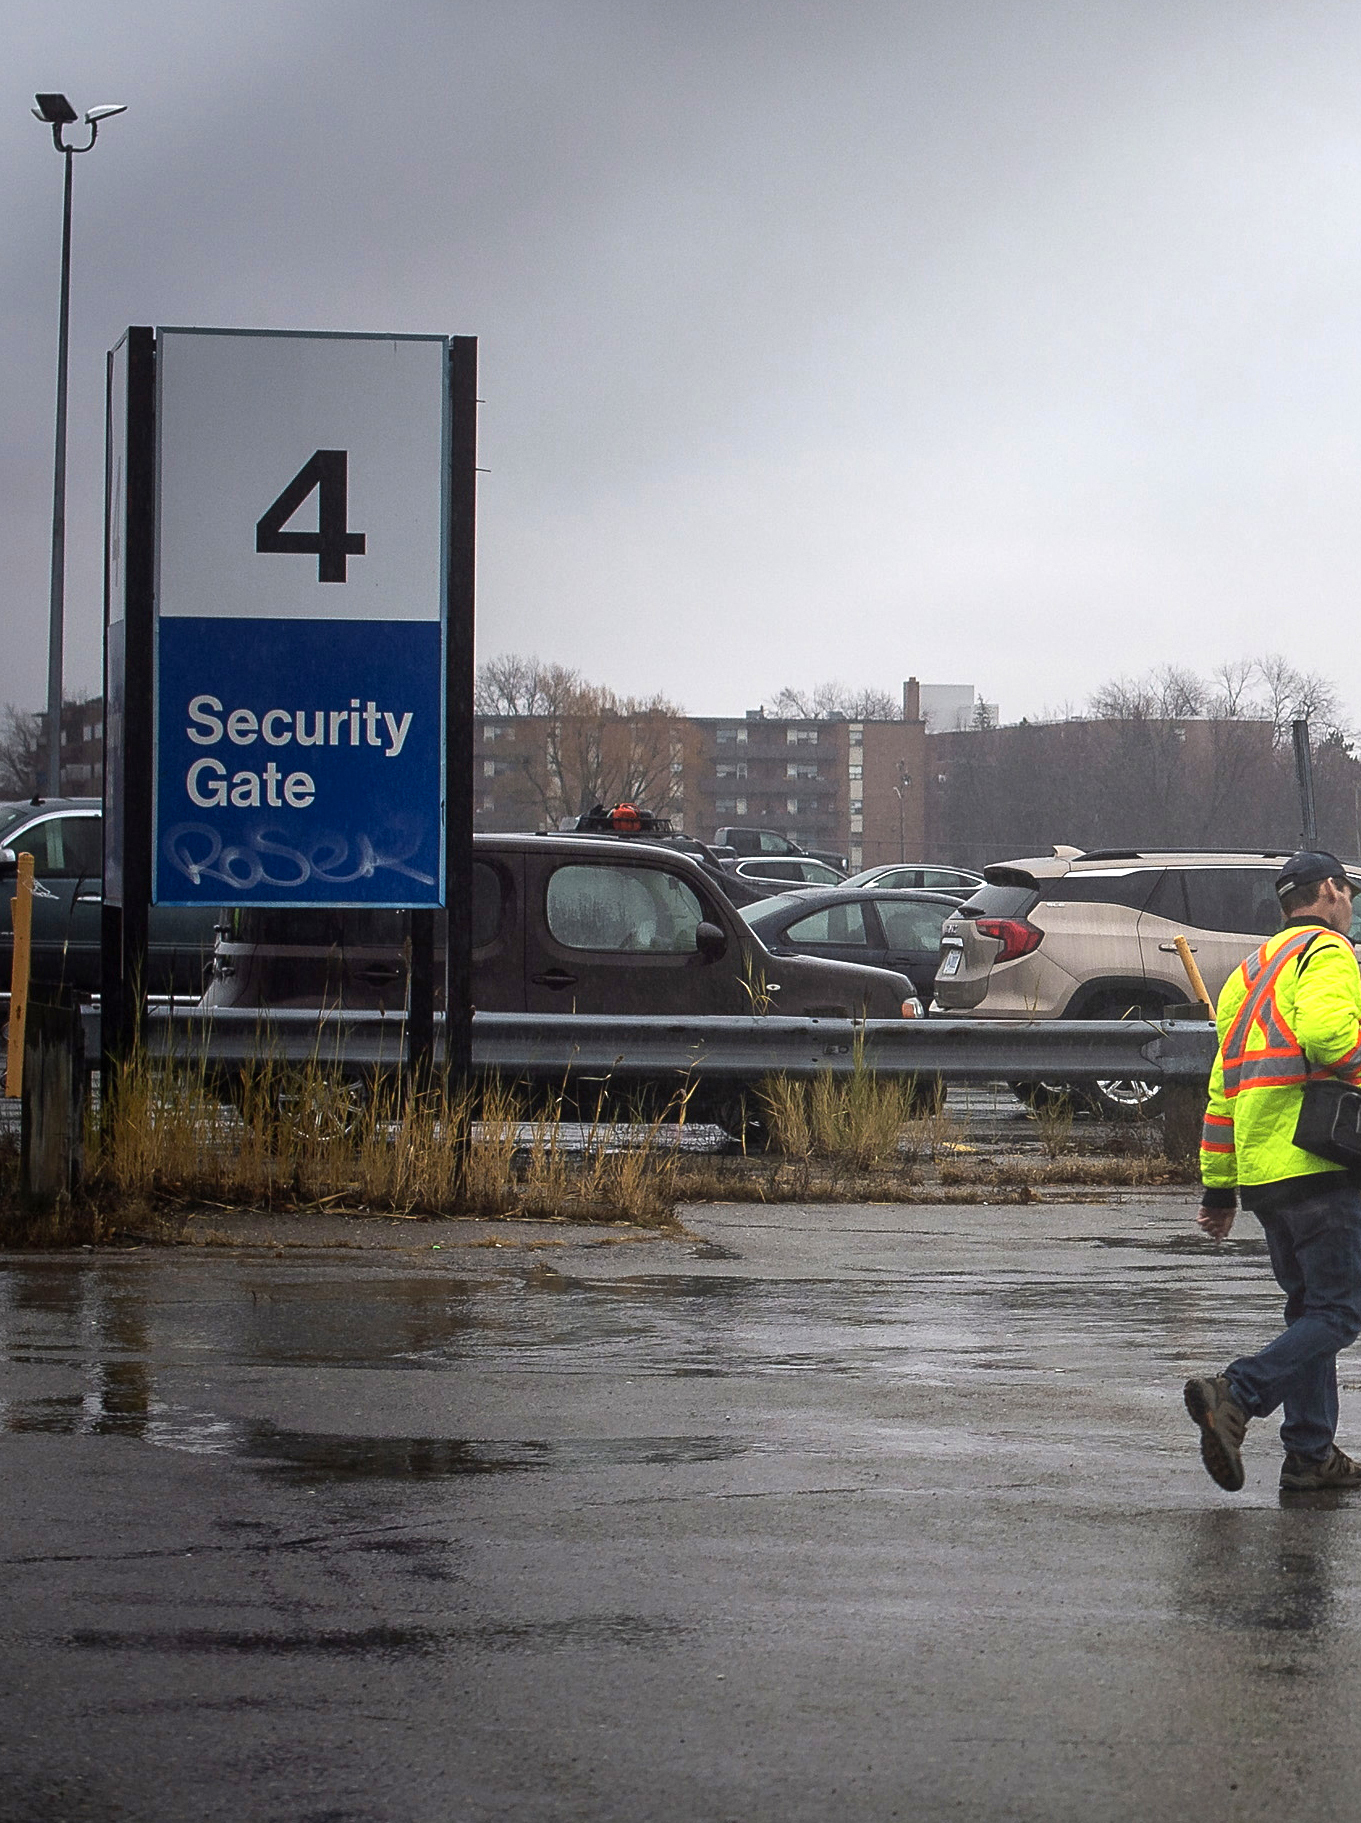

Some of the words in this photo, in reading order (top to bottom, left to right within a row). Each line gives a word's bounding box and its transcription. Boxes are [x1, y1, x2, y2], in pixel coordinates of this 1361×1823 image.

[255, 449, 366, 584] 4
[186, 694, 414, 757] Security
[186, 757, 316, 808] Gate
